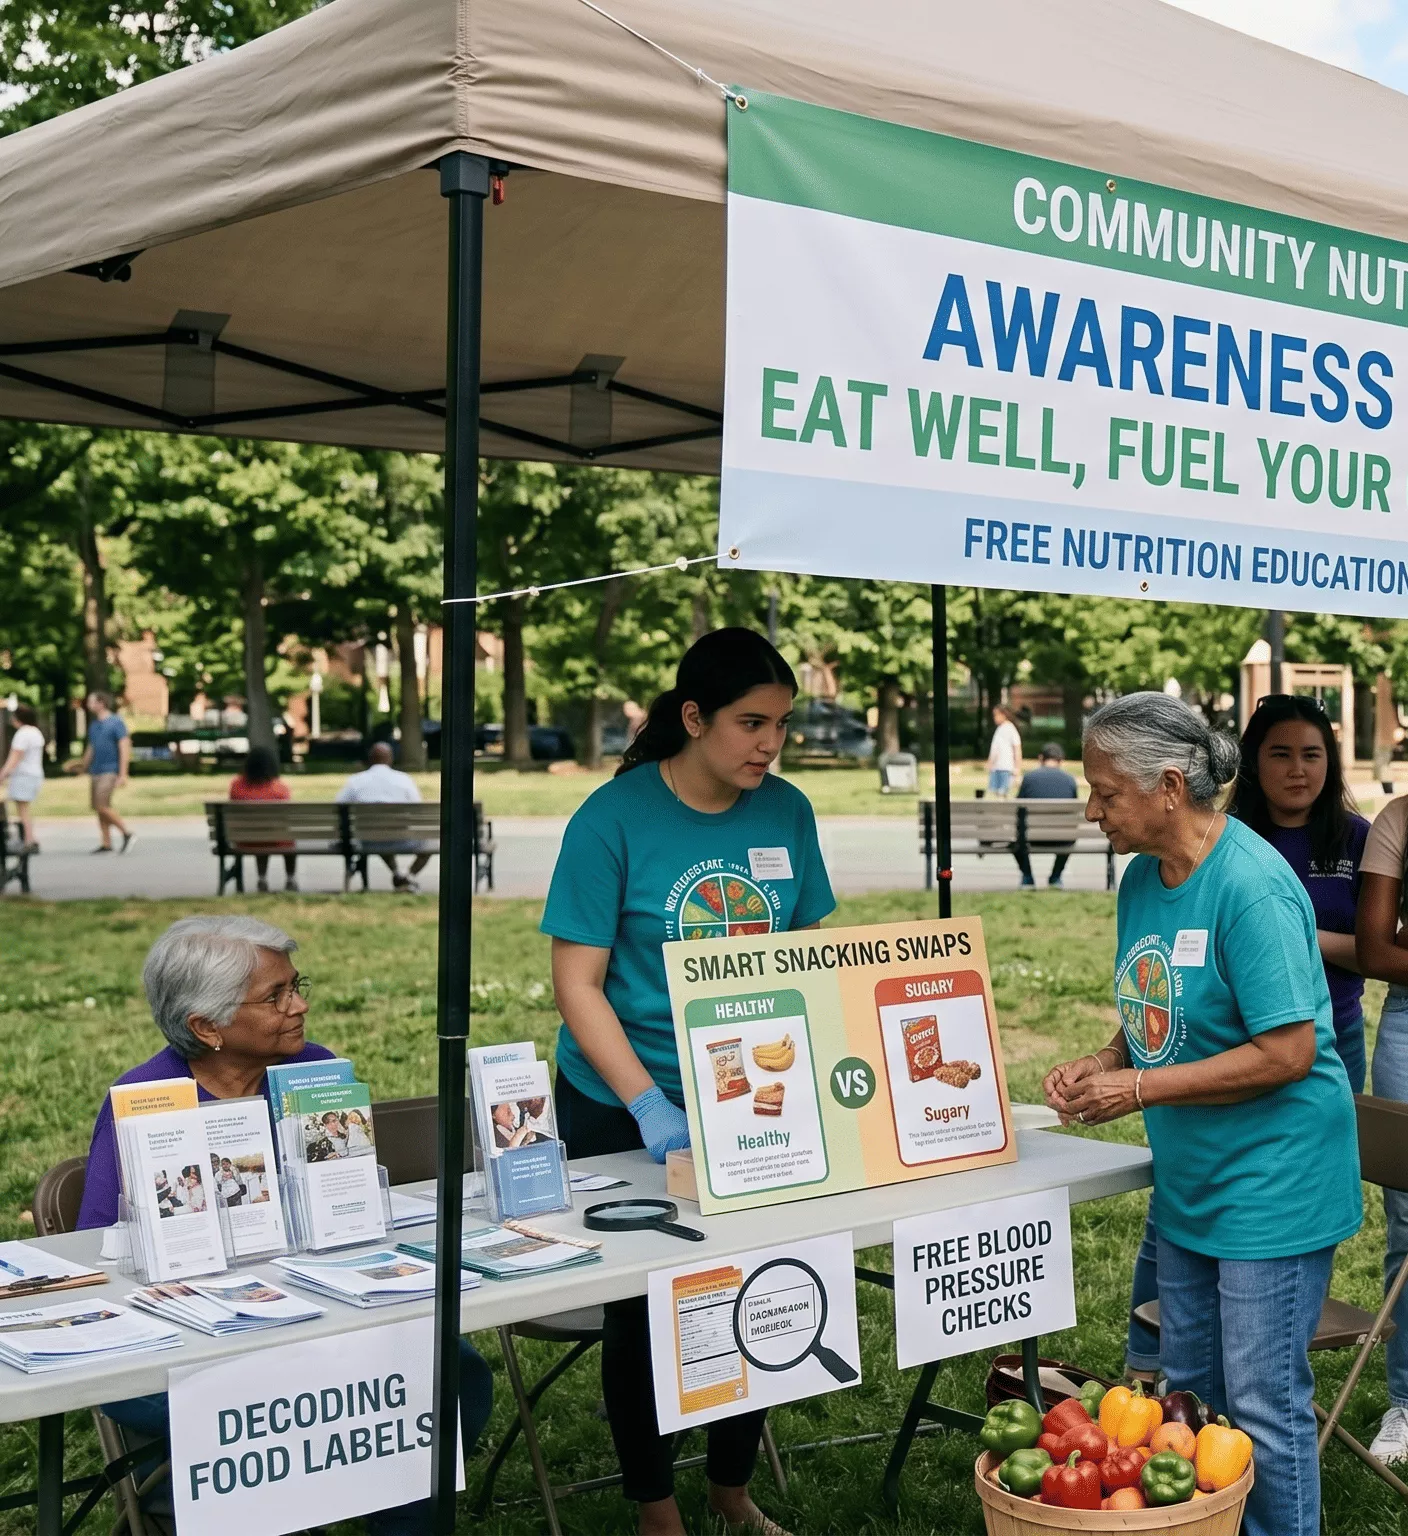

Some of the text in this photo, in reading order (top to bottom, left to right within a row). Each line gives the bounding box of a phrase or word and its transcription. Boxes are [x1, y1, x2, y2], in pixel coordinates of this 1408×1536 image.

[1013, 176, 1316, 290] COMMUNITY
[922, 272, 1394, 430] AWARENESS
[761, 367, 888, 451] EAT
[907, 387, 1086, 490] WELL,
[1108, 416, 1239, 495] FUEL
[1256, 437, 1391, 513] YOUR
[964, 517, 1052, 565] FREE
[1062, 527, 1242, 581] NUTRITION
[683, 931, 973, 984] SMART SNACKING SWAPS
[715, 998, 776, 1019] HEALTHY
[905, 978, 955, 998] SUGARY
[835, 1068, 869, 1099] VS
[924, 1103, 971, 1124] Sugary
[737, 1130, 791, 1151] Healthy
[912, 1220, 1052, 1273] FREE BLOOD
[925, 1254, 1045, 1305] PRESSURE
[941, 1291, 1032, 1336] CHECKS
[217, 1373, 407, 1447] DECODING
[189, 1411, 434, 1501] FOOD LABELS
